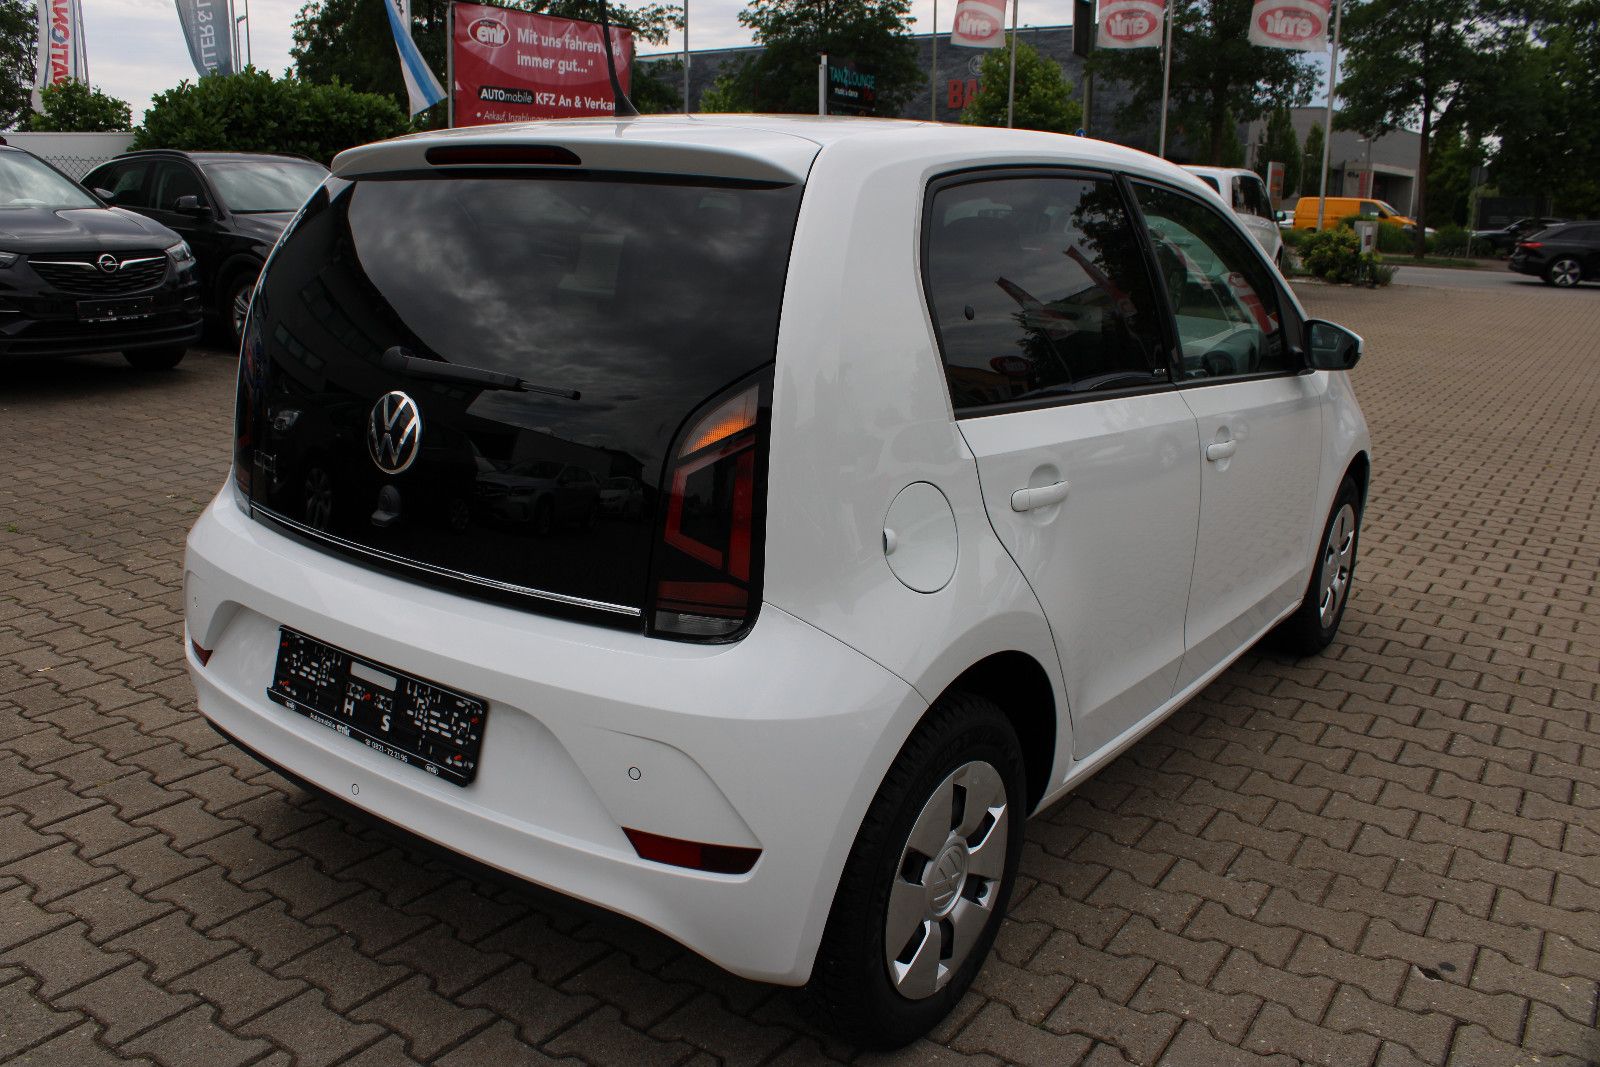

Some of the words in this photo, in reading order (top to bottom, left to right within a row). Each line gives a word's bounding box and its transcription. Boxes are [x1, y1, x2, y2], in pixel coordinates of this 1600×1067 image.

[517, 27, 538, 45] Mit
[541, 34, 562, 48] uns
[565, 33, 600, 53] fahren
[517, 50, 555, 69] immer
[480, 88, 533, 103] AUTOmobile
[535, 92, 556, 106] KFZ
[558, 94, 572, 108] An
[574, 95, 582, 108] &
